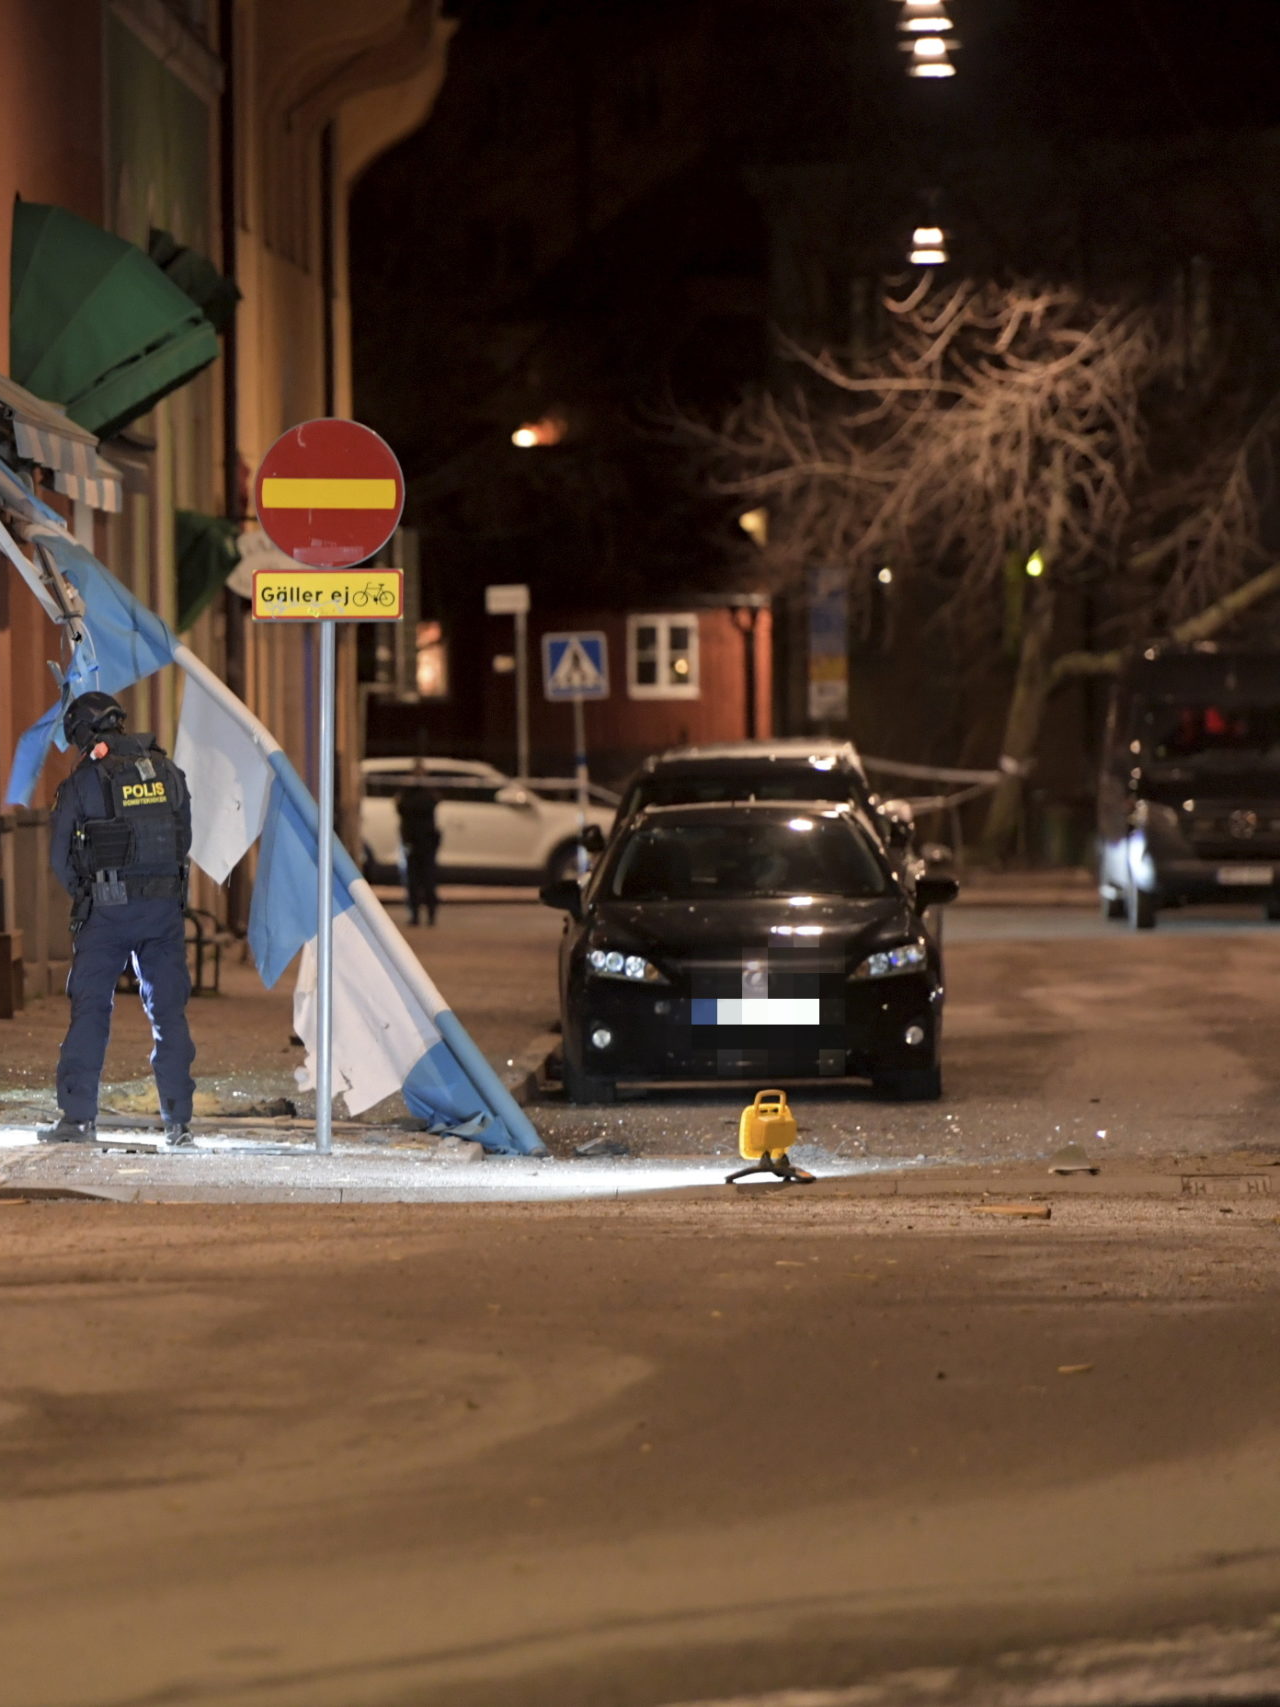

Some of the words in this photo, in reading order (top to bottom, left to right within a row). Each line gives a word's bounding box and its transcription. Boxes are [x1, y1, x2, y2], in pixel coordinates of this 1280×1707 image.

[261, 586, 323, 603] Gäller
[331, 586, 349, 606] ej
[123, 782, 164, 799] POLIS
